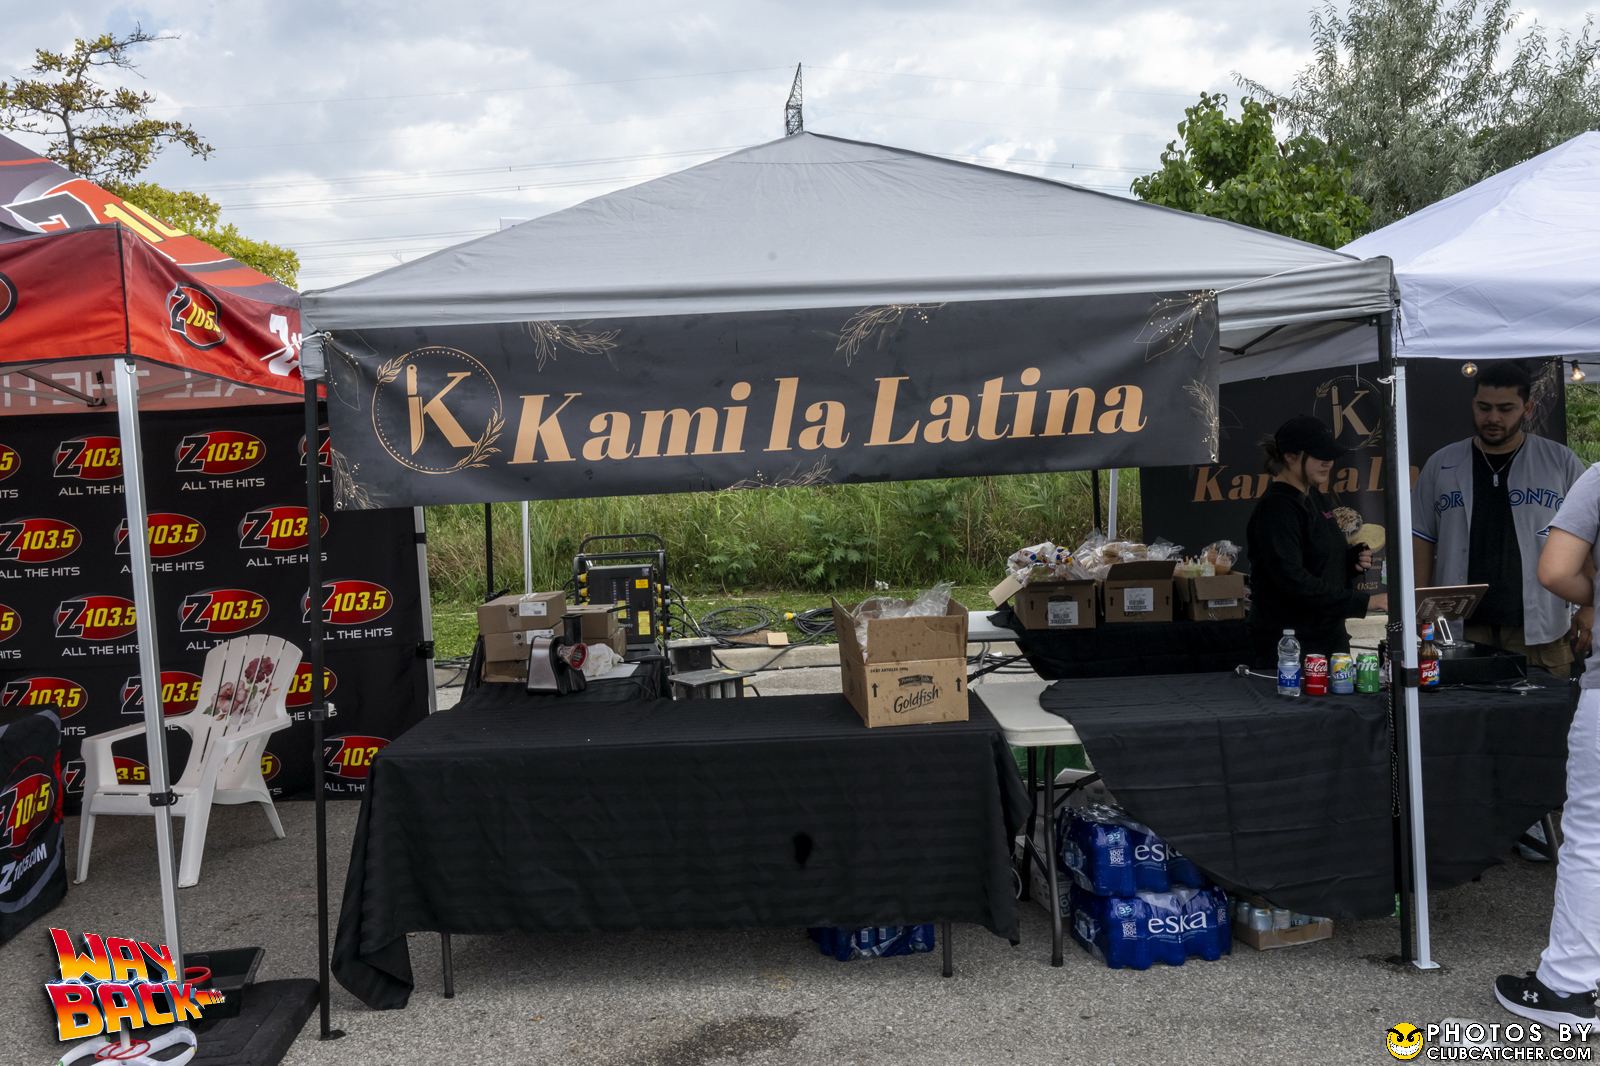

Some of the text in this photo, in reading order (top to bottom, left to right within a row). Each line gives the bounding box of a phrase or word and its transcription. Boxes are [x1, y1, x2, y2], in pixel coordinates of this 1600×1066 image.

[507, 367, 1147, 465] Kami la Latina
[53, 440, 122, 477] Z103.
[175, 434, 260, 472] Z103.5
[58, 486, 84, 496] ALL
[86, 485, 110, 494] THE
[181, 478, 266, 491] ALL THE HITS
[239, 511, 308, 548] Z103.
[175, 561, 205, 571] HITS
[246, 558, 272, 568] ALL
[275, 555, 297, 564] THE
[24, 567, 49, 577] THE
[51, 566, 81, 577] HITS
[180, 594, 263, 632] Z103.5
[337, 630, 362, 639] THE
[364, 627, 393, 638] HITS
[62, 648, 87, 656] ALL
[89, 645, 114, 655] THE
[186, 640, 211, 650] ALL
[893, 685, 939, 713] Goldfish
[1119, 905, 1132, 915] 35
[1148, 911, 1207, 934] eska
